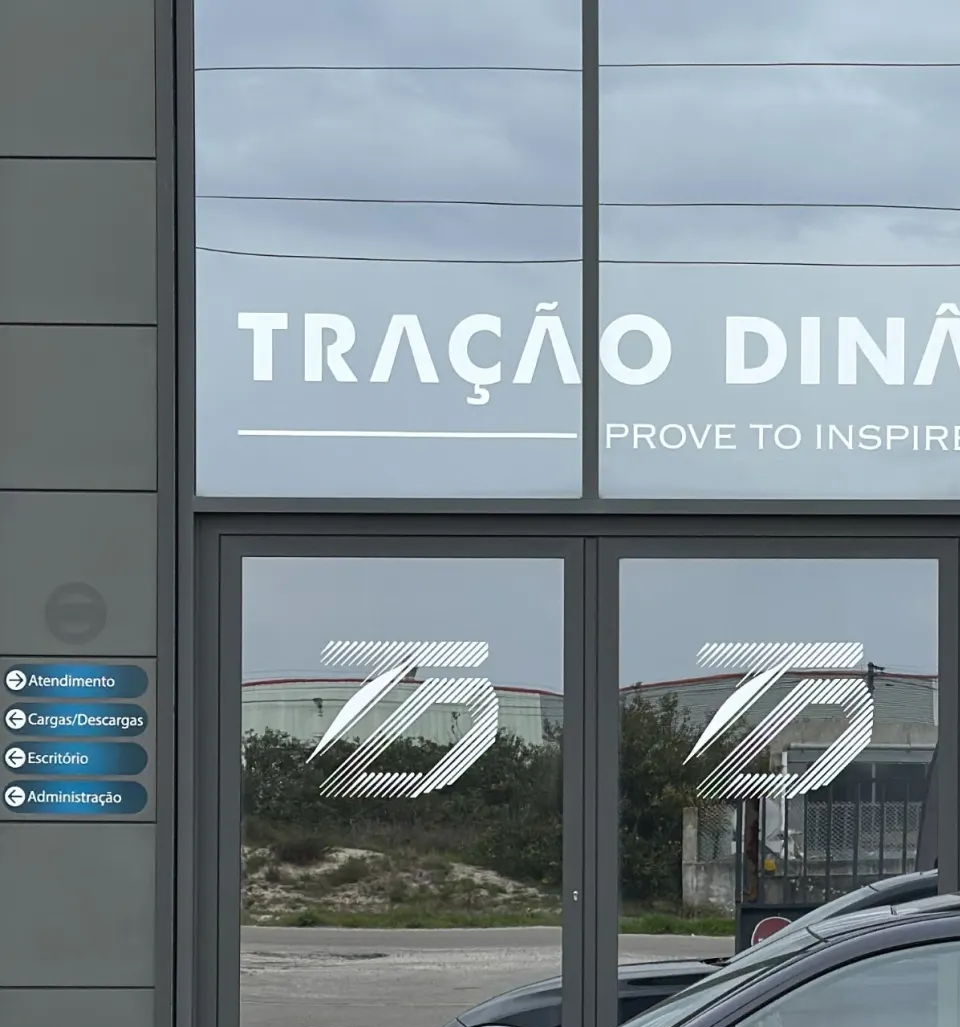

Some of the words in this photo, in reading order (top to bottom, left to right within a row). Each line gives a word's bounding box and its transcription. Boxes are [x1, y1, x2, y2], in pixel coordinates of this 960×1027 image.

[237, 301, 672, 405] TRAÇÃO
[605, 423, 737, 450] PROVE
[749, 423, 802, 450] TO
[28, 674, 115, 688] Atendimento
[28, 712, 144, 729] Cargas/Descargas
[28, 750, 89, 765] Escritório
[27, 790, 122, 807] Administração
